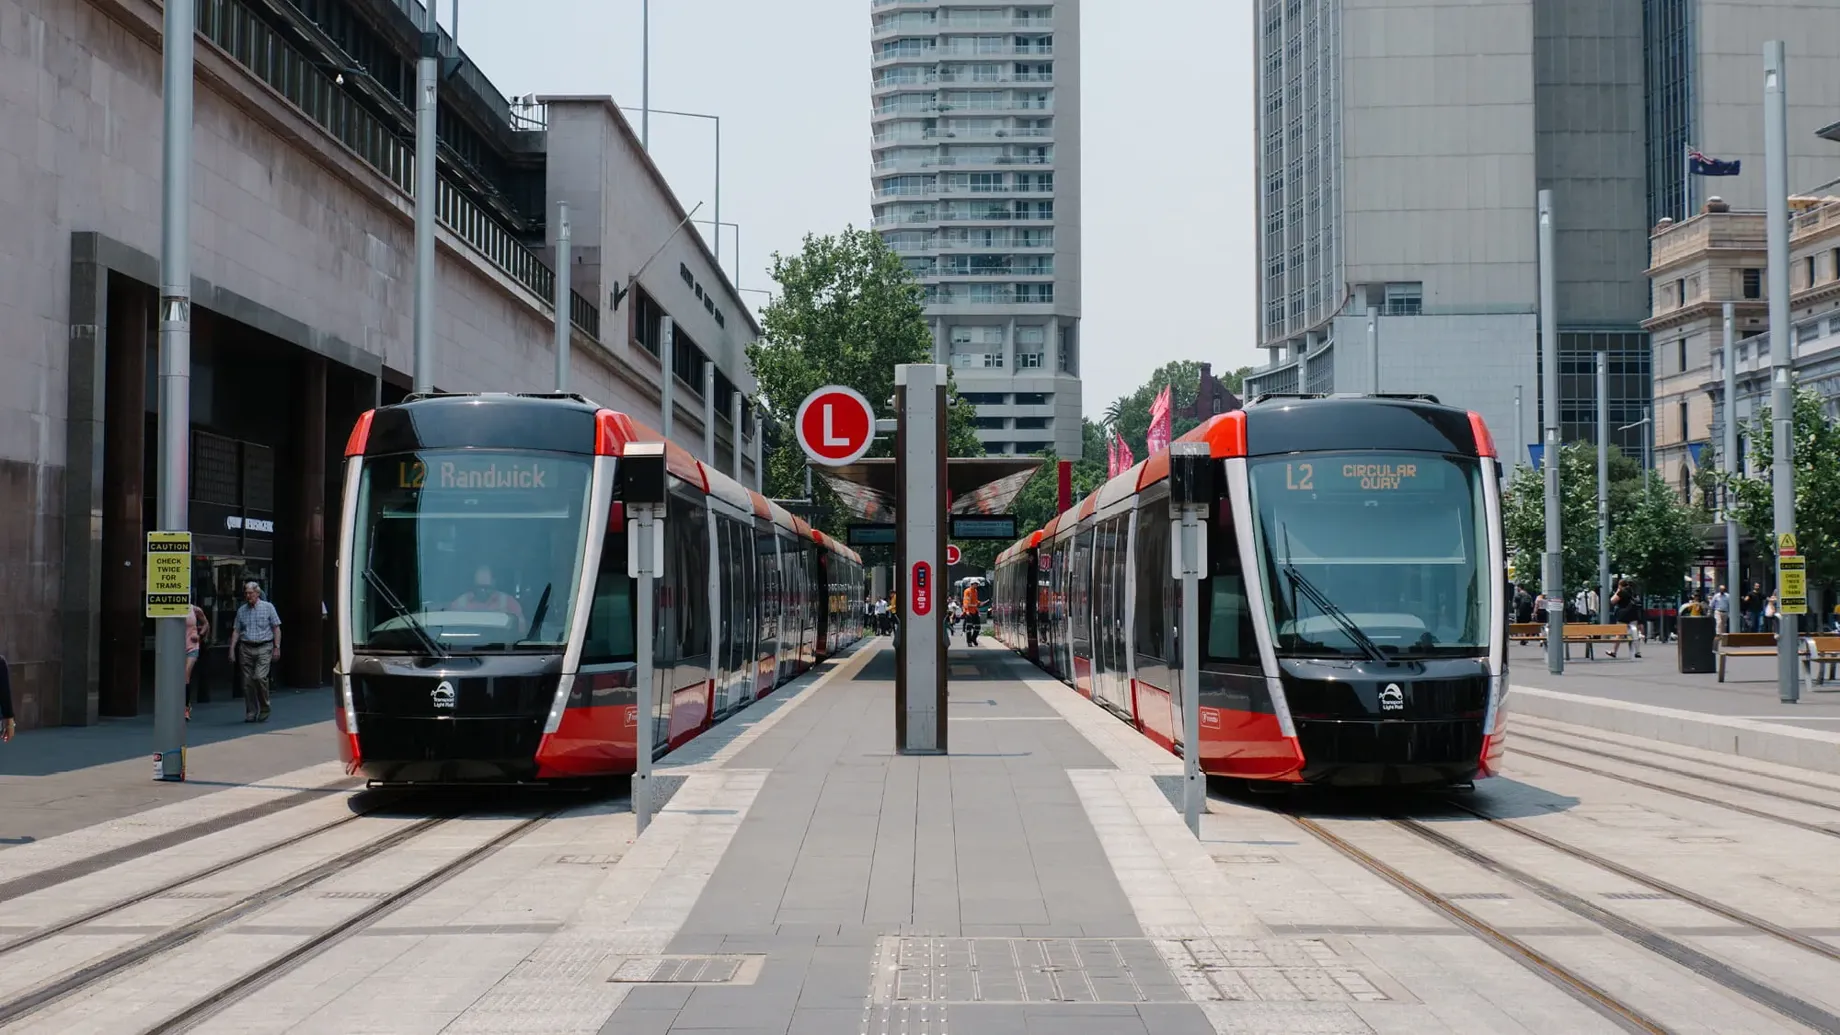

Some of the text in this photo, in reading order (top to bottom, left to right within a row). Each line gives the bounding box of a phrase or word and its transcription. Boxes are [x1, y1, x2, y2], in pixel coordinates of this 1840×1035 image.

[822, 403, 850, 447] L
[399, 461, 546, 489] L2 Randwick
[1286, 463, 1417, 490] L2 CIRCULAR
[150, 543, 189, 551] CAUTION
[156, 557, 182, 565] CHECK
[149, 595, 188, 603] CAUTION
